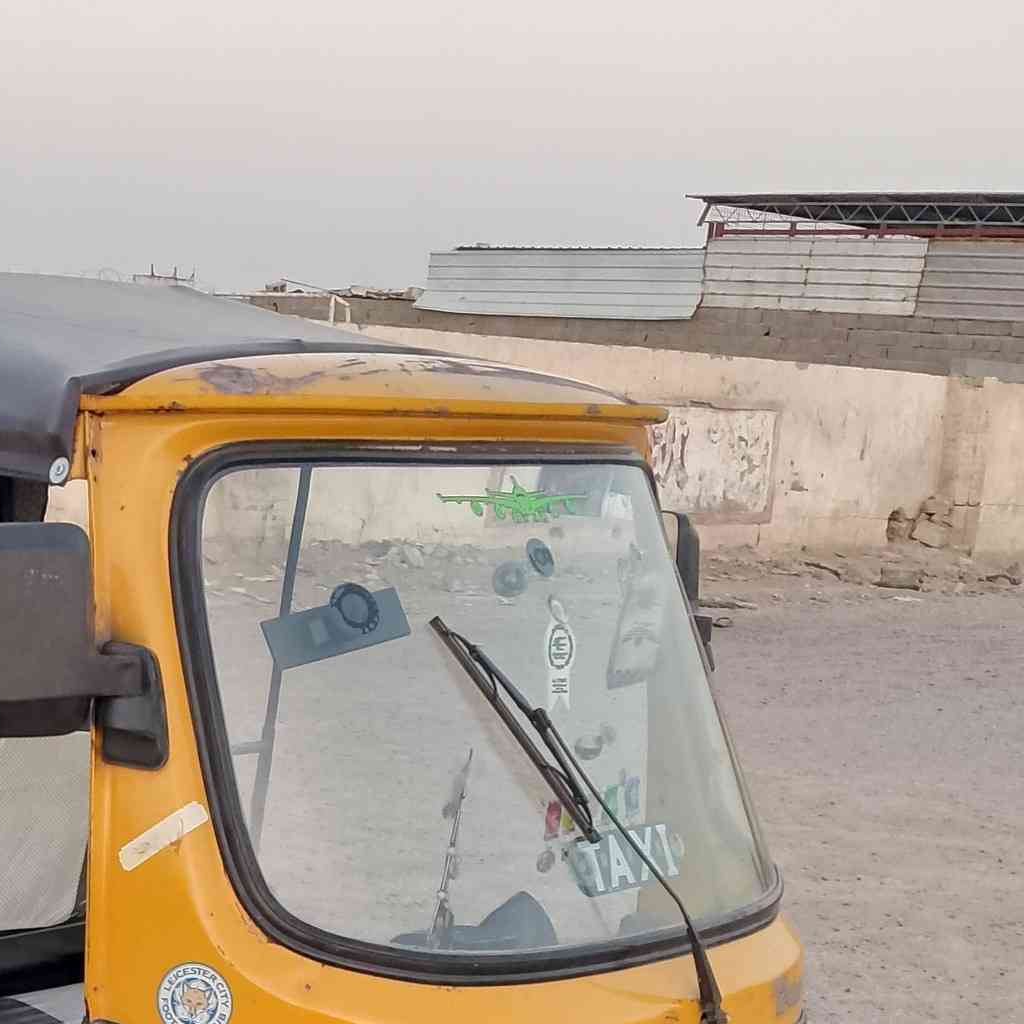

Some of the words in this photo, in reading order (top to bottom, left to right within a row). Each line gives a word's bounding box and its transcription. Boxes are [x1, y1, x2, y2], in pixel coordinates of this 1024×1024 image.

[576, 824, 680, 891] TAXI
[164, 967, 218, 992] LEICESTER
[216, 982, 230, 1008] CITY
